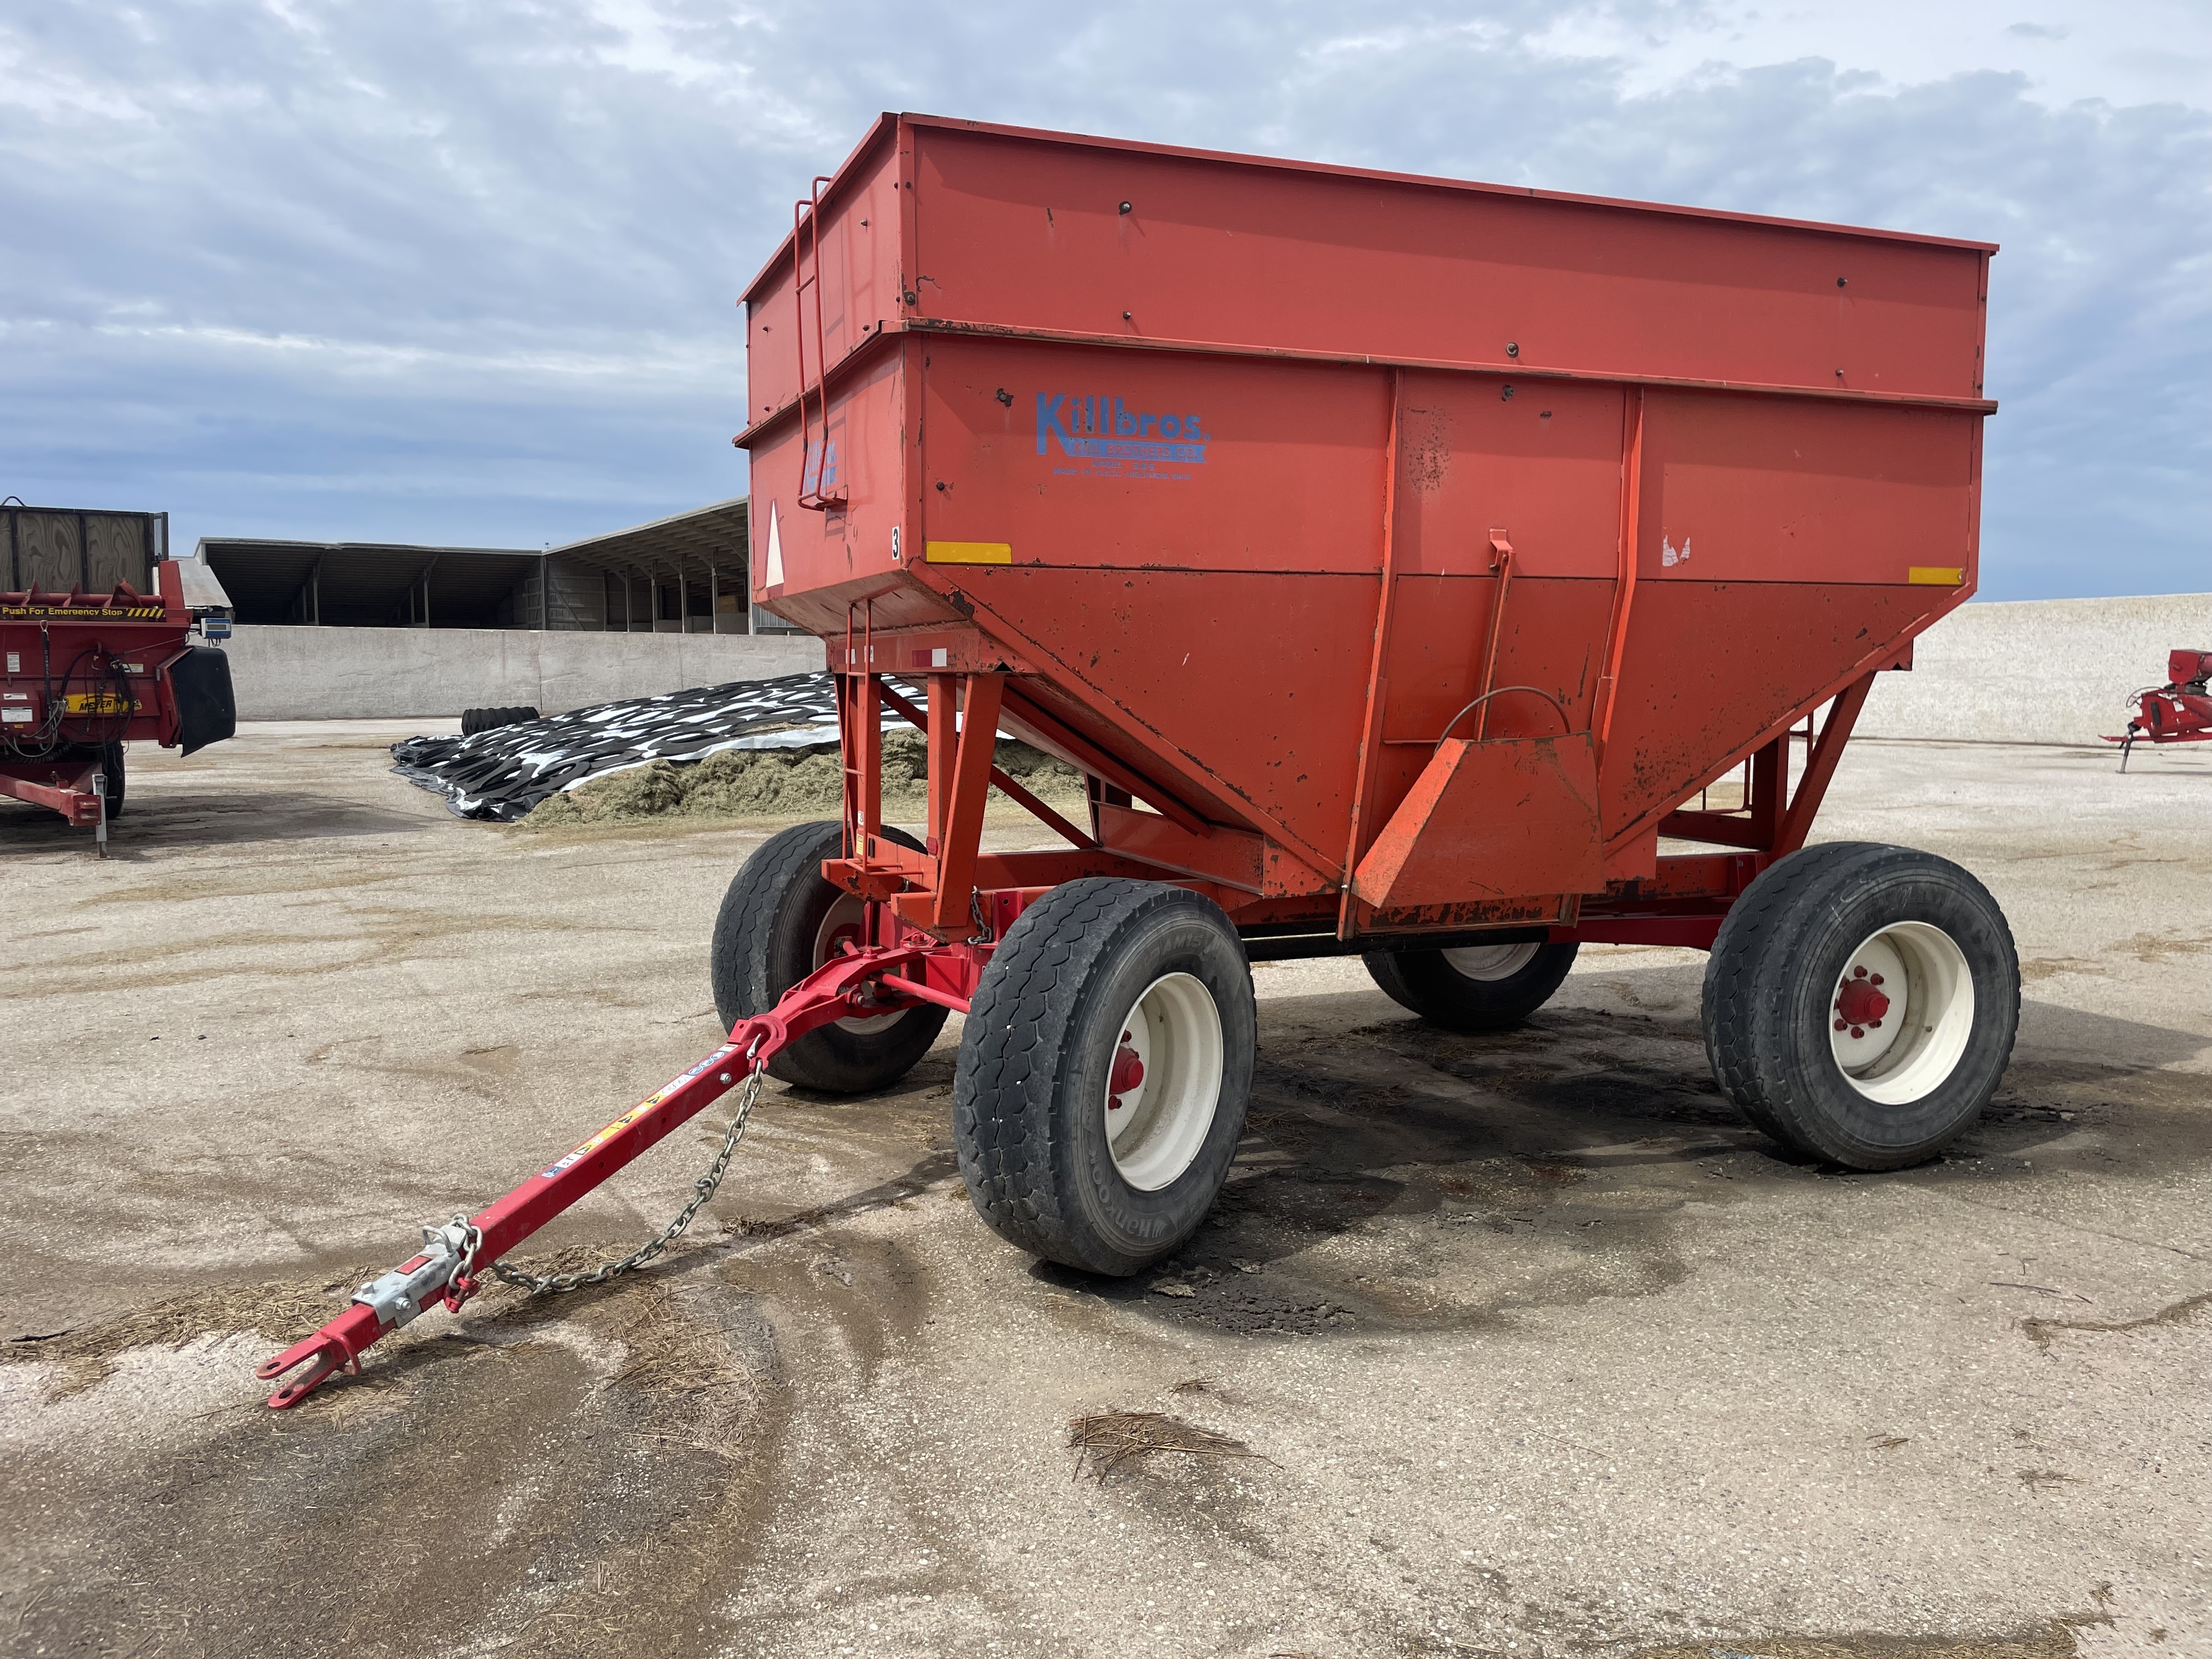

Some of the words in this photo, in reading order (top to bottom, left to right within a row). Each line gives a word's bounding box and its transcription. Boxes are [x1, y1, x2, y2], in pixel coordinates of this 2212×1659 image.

[1074, 441, 1100, 454] KILL
[1107, 444, 1170, 458] BROTHERS
[1176, 448, 1198, 459] CO.
[1092, 460, 1122, 469] MODEL
[893, 528, 899, 558] 3
[48, 608, 99, 616] Emergency
